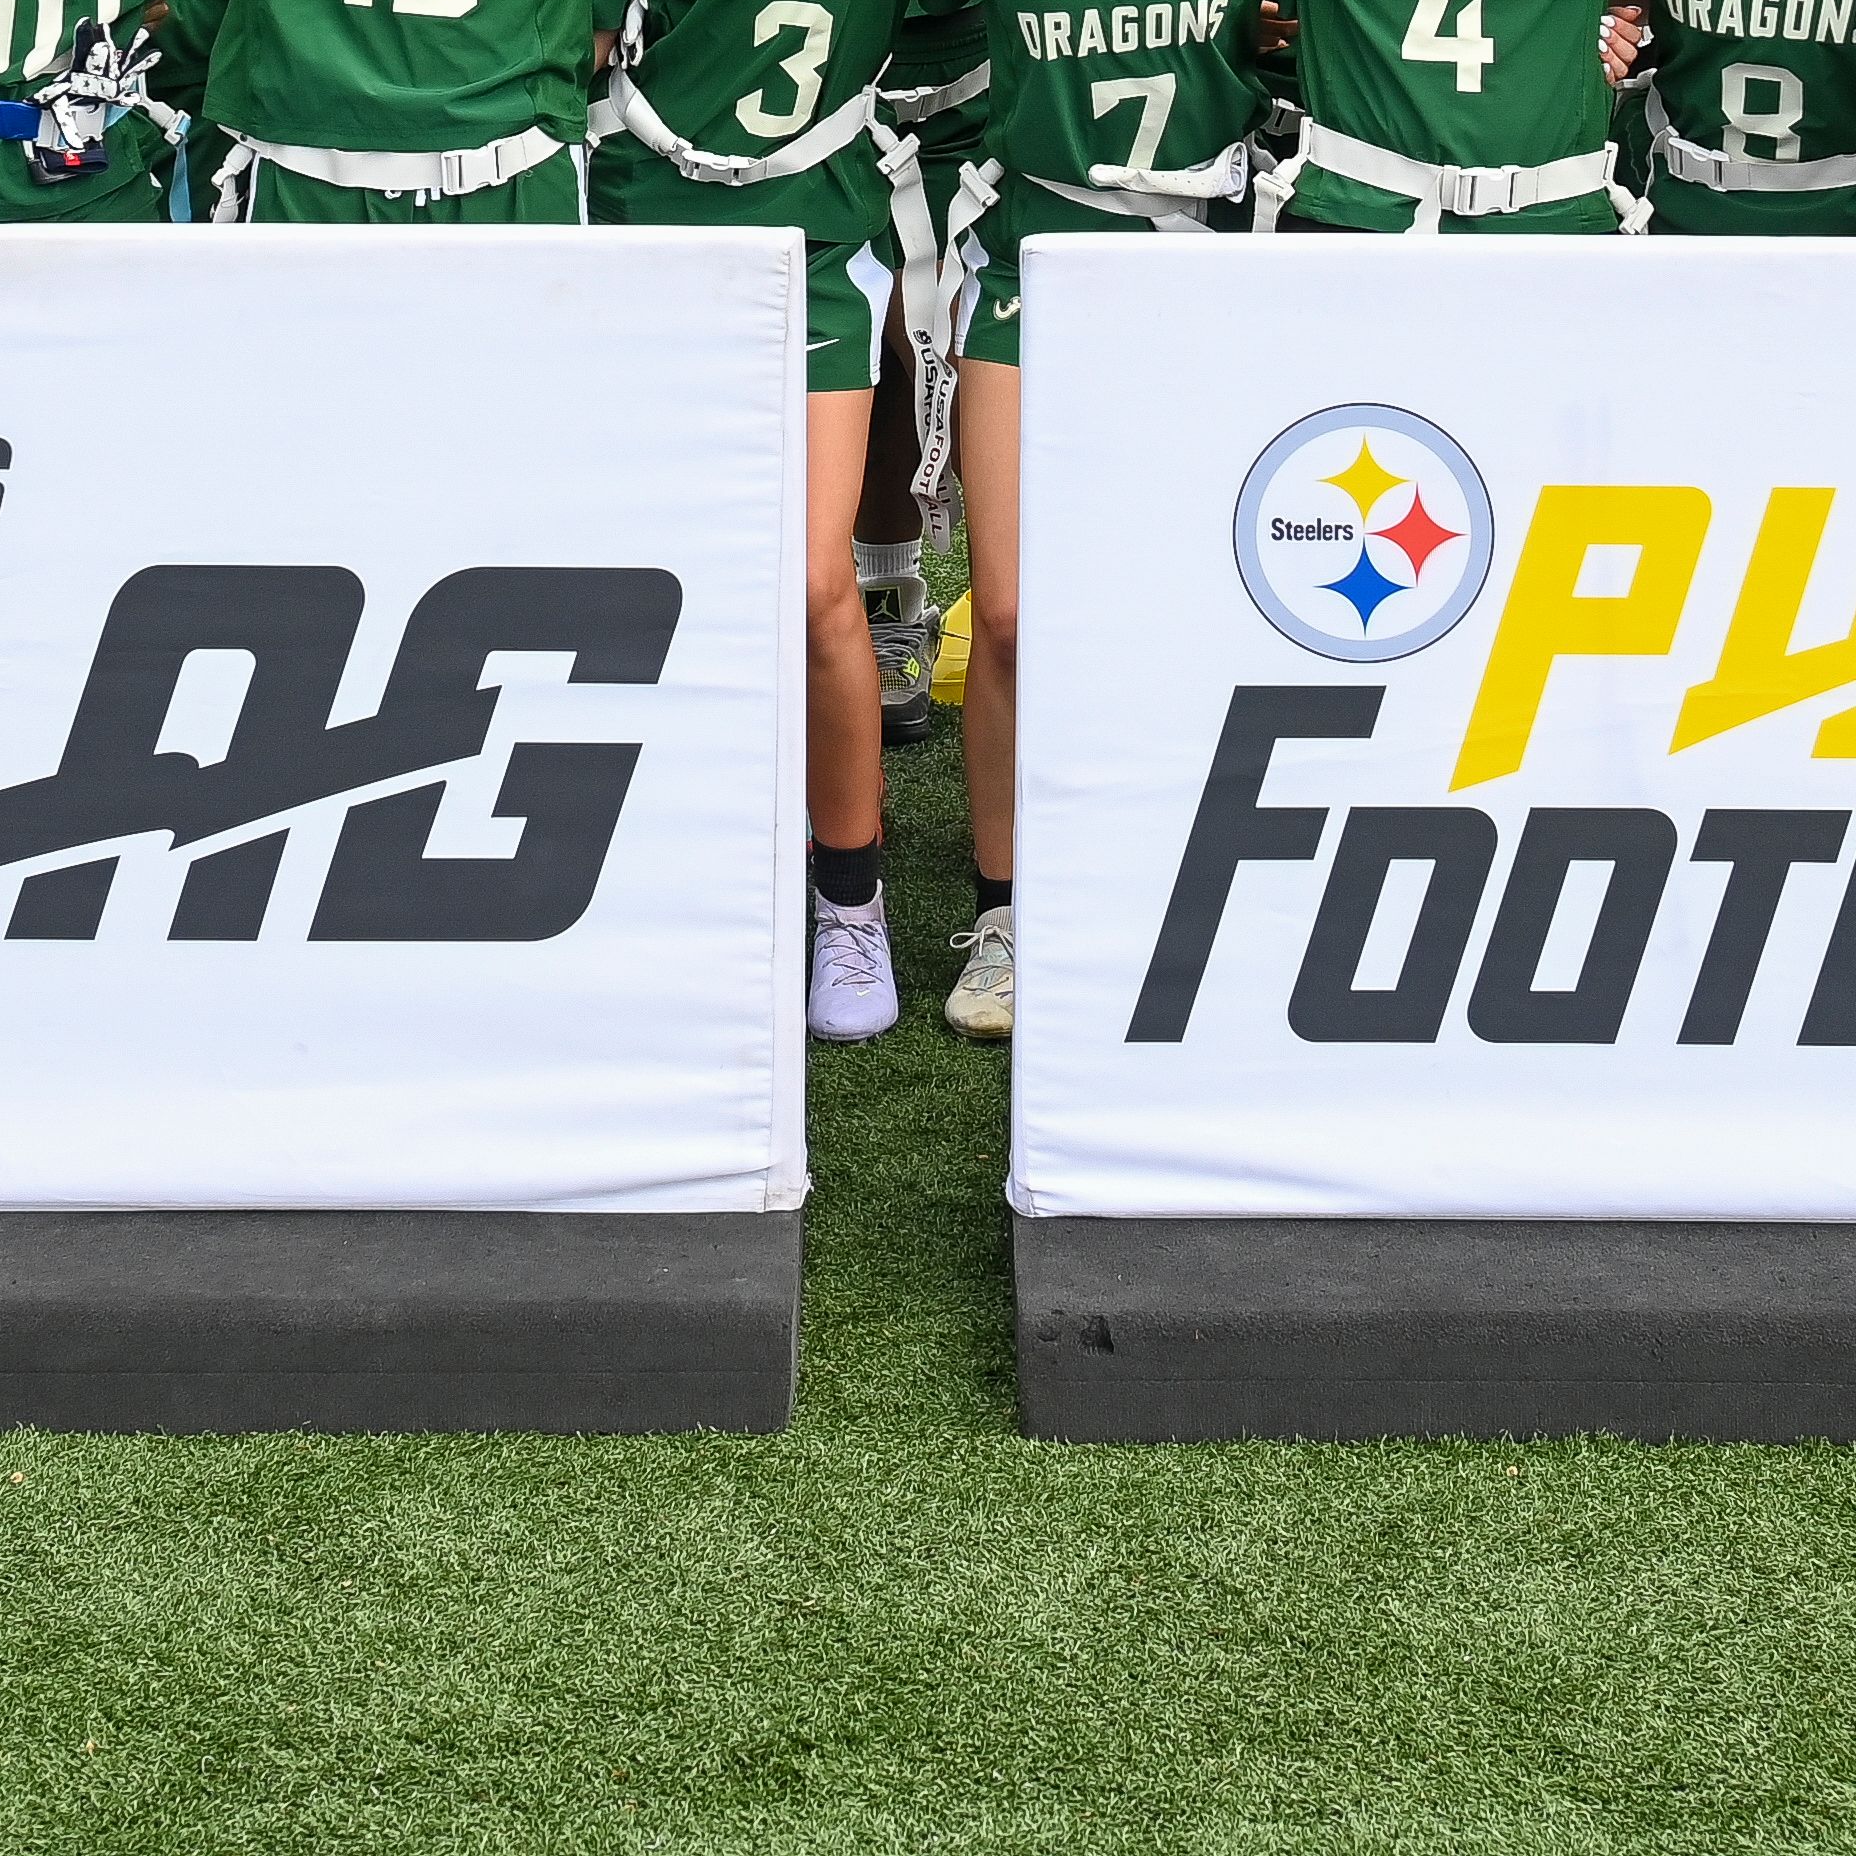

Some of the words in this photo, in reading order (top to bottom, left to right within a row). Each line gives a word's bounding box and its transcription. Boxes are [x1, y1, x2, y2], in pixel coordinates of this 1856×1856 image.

[735, 0, 834, 138] 3
[1721, 62, 1804, 164] 8
[1090, 73, 1176, 171] 7
[1271, 517, 1354, 541] Steelers
